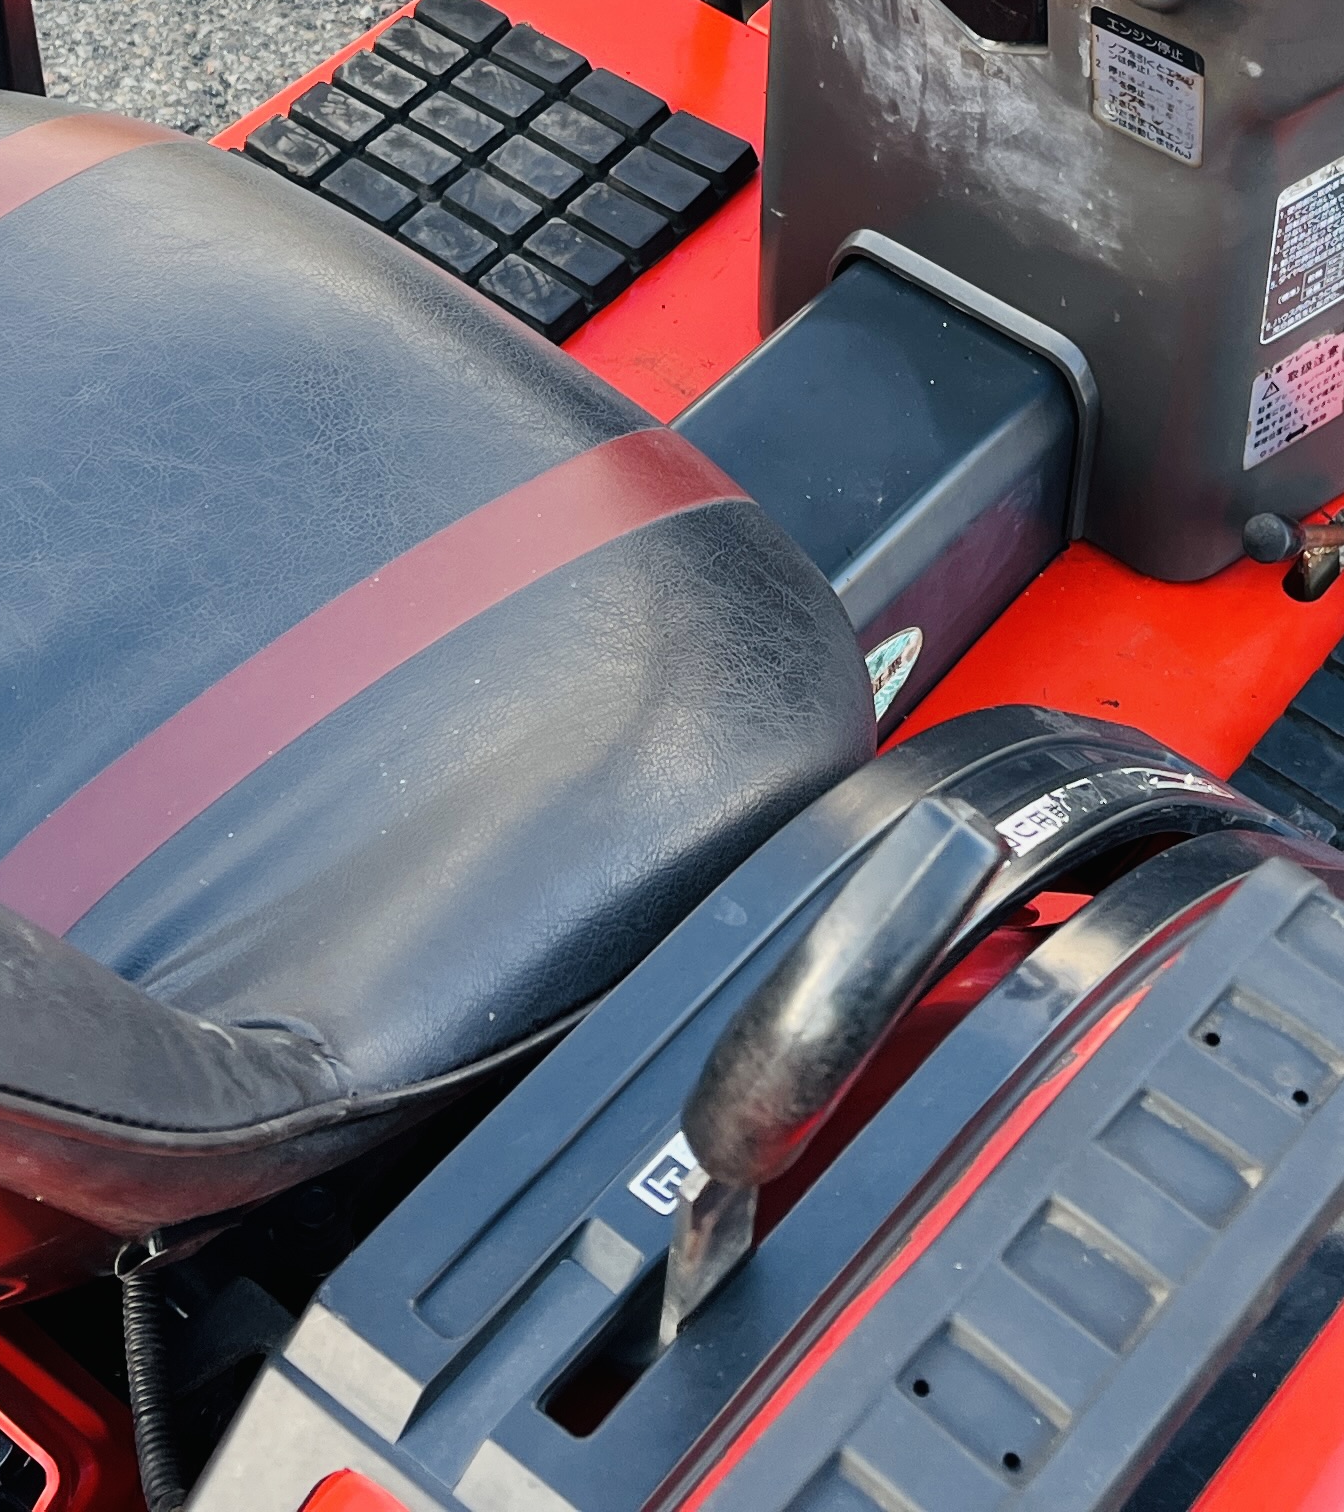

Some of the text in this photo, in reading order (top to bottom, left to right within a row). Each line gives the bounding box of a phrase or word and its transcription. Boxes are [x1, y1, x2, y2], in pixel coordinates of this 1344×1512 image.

[1107, 17, 1184, 63] エンジン停止
